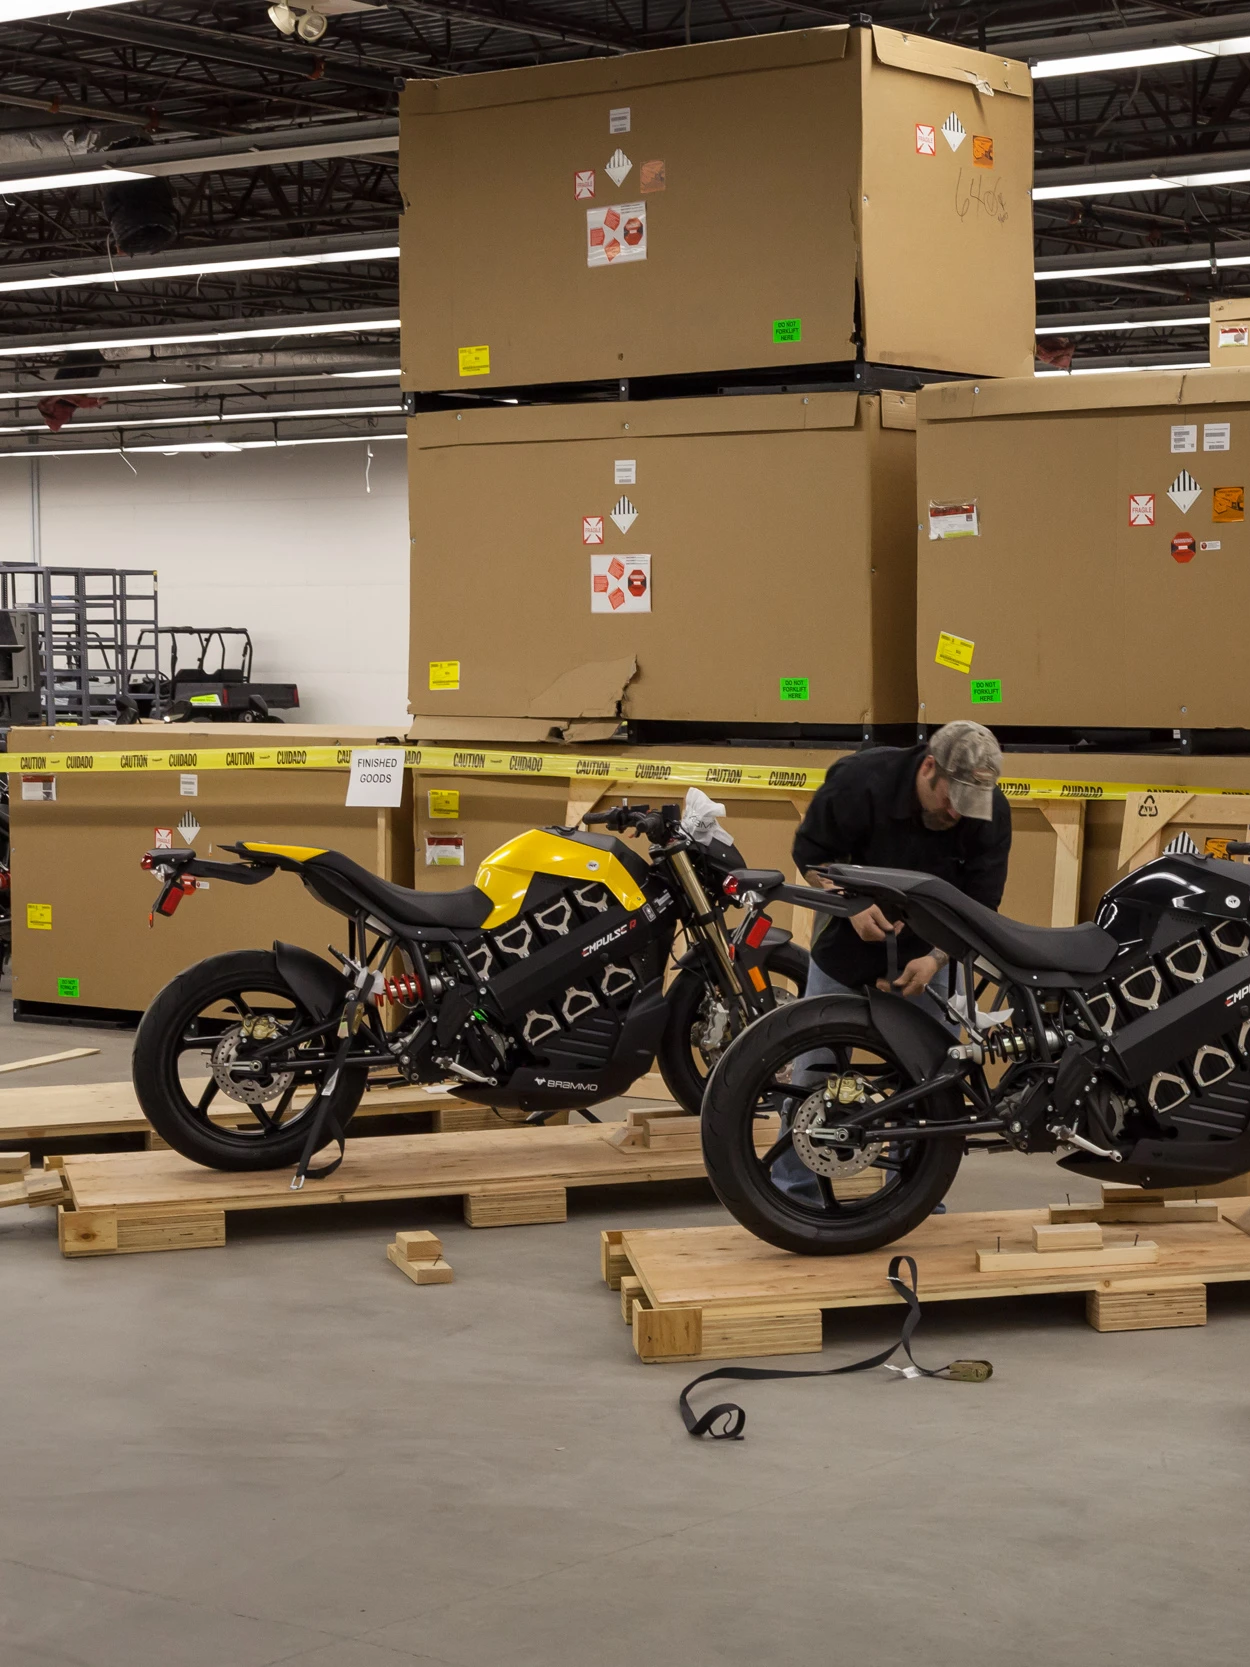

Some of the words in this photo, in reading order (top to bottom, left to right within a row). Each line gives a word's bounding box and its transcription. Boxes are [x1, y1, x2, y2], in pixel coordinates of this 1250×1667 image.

[1132, 506, 1152, 514] FRAGILE
[357, 758, 398, 768] FINISHED
[20, 756, 46, 770] CAUTION
[66, 756, 93, 769] CUIDADO
[120, 754, 148, 768] CAUTION
[169, 753, 197, 767] CUIDADO
[226, 752, 255, 766] CAUTION
[277, 750, 307, 765] CUIDADO
[453, 753, 486, 768] CAUTION
[509, 755, 543, 772] CUIDADO
[576, 760, 610, 776] CAUTION
[635, 763, 671, 780] CUIDADO
[706, 768, 742, 784] CAUTION
[768, 771, 807, 787] CUIDADO
[1062, 785, 1103, 798] CUIDADO
[360, 773, 392, 784] GOODS
[581, 924, 627, 957] EMPULSE
[629, 919, 637, 930] R
